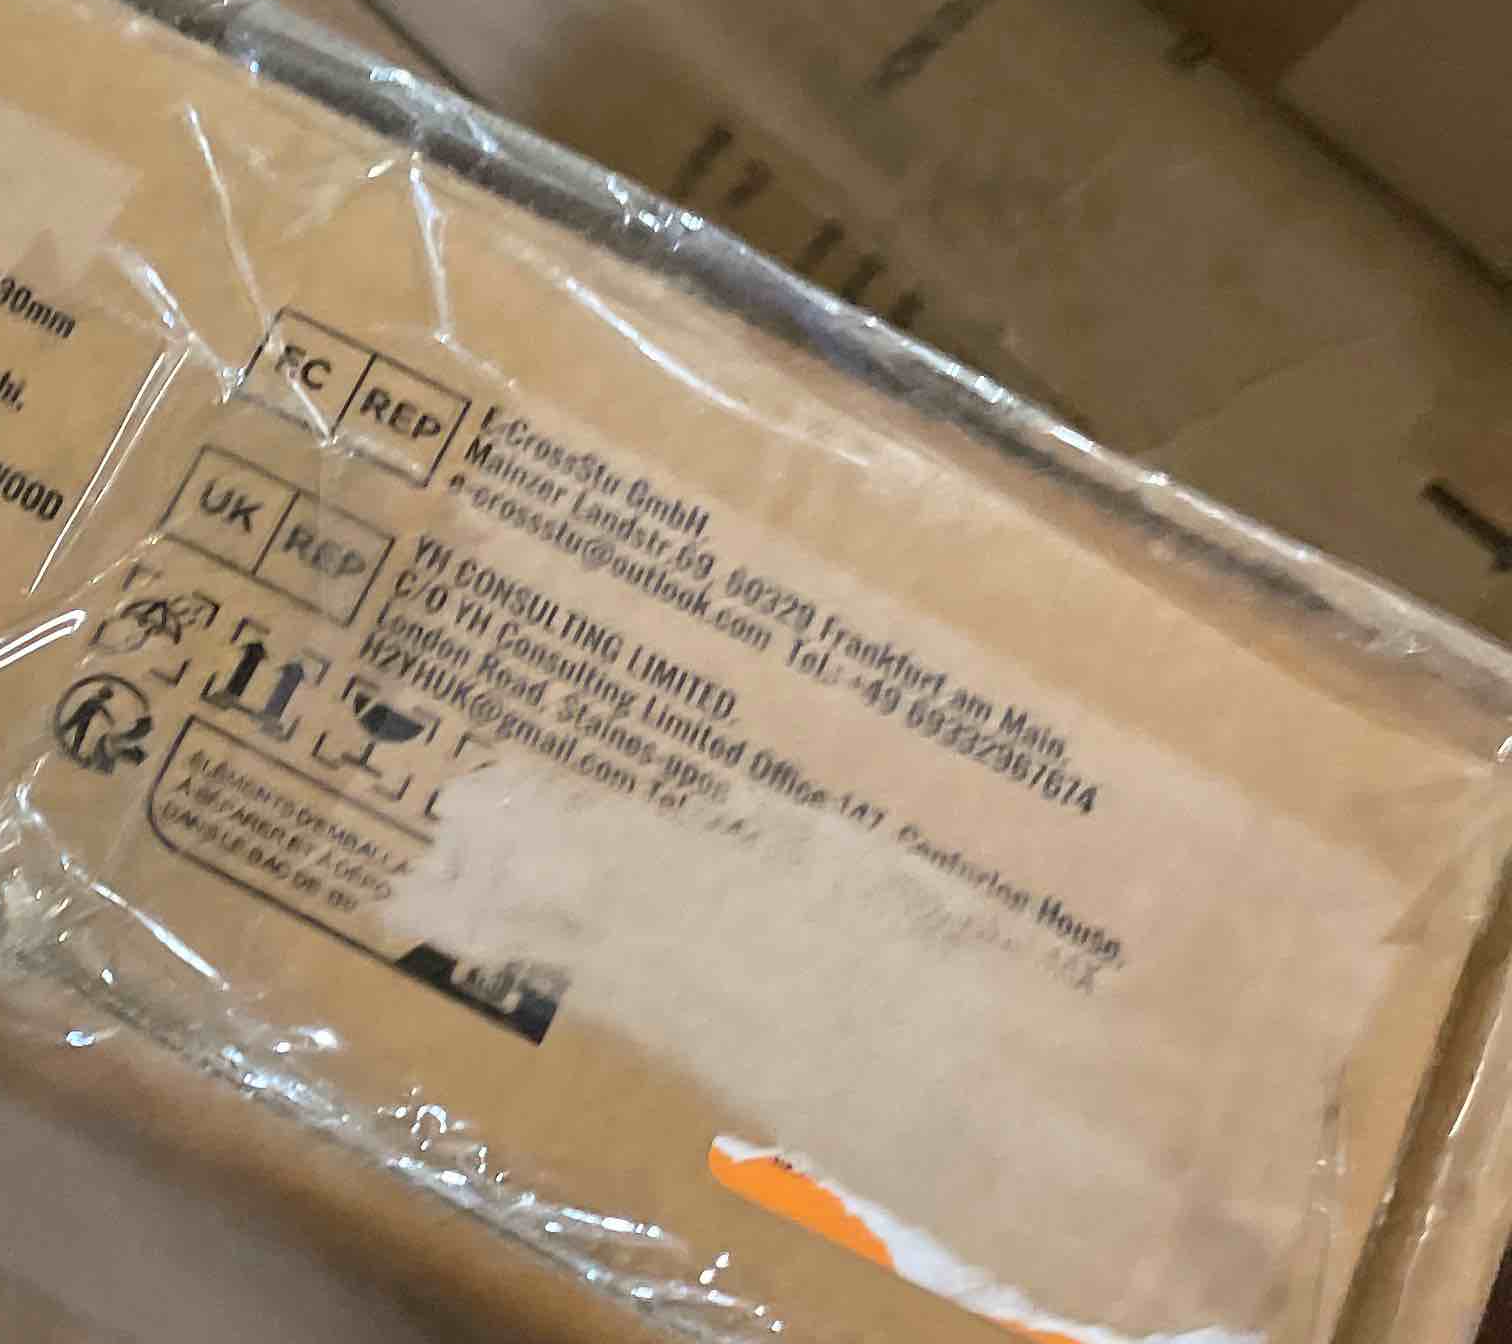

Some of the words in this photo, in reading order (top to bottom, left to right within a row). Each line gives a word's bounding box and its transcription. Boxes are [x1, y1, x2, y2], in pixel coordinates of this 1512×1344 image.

[359, 387, 442, 439] REP
[200, 481, 261, 533] UK
[282, 524, 366, 576] REP
[464, 436, 566, 503] Mainzer
[726, 569, 816, 631] 60329
[819, 615, 947, 696] Frankfurt
[951, 691, 993, 721] am
[376, 601, 471, 667] London
[414, 535, 453, 574] YH
[455, 559, 623, 663] CONSULTING
[394, 569, 449, 613] C/O
[455, 602, 493, 635] YH
[486, 621, 637, 717] Consulting
[642, 695, 747, 765] Limited
[749, 751, 828, 805] Office
